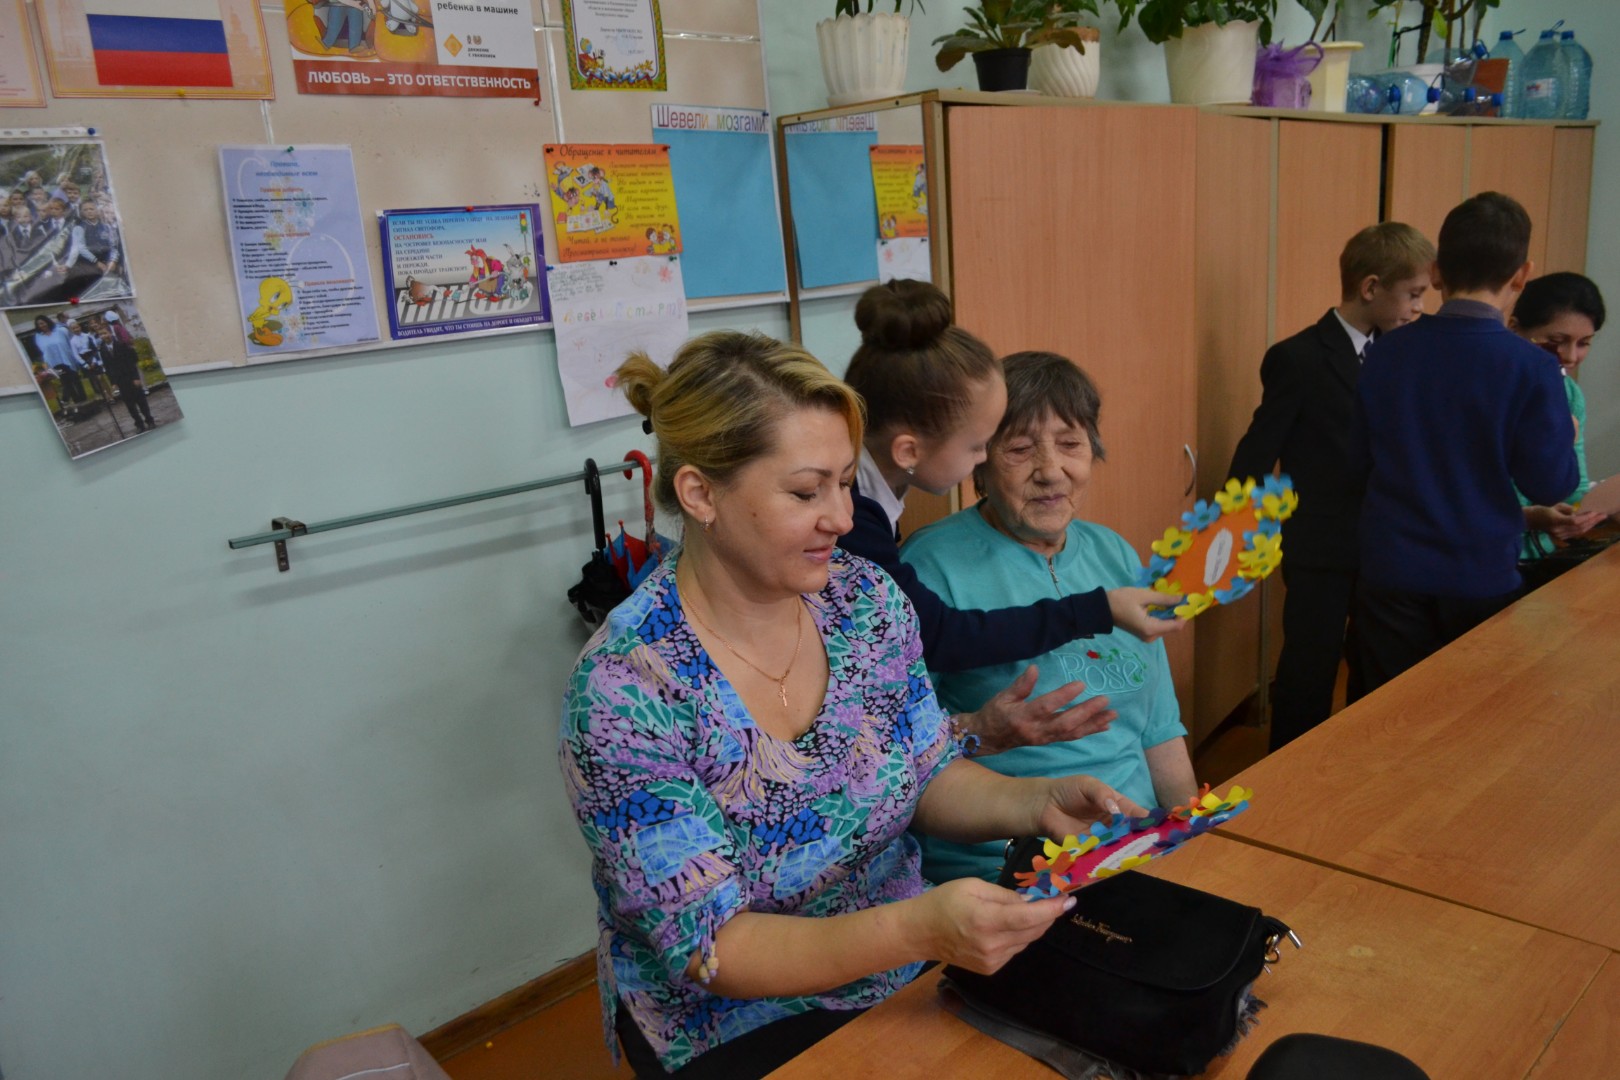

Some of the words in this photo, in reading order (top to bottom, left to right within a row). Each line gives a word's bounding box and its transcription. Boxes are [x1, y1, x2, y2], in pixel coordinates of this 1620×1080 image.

[437, 2, 474, 12] ребенка
[483, 6, 519, 15] машине
[308, 71, 371, 85] ЛЮБОВЬ
[387, 73, 413, 86] ЭТО
[416, 74, 532, 90] ОТВЕТСТВЕННОСТЬ
[657, 105, 709, 129] Шевели
[560, 144, 603, 160] Обращение
[615, 147, 657, 156] читателям
[397, 329, 422, 337] ВОДИТЕЛЬ
